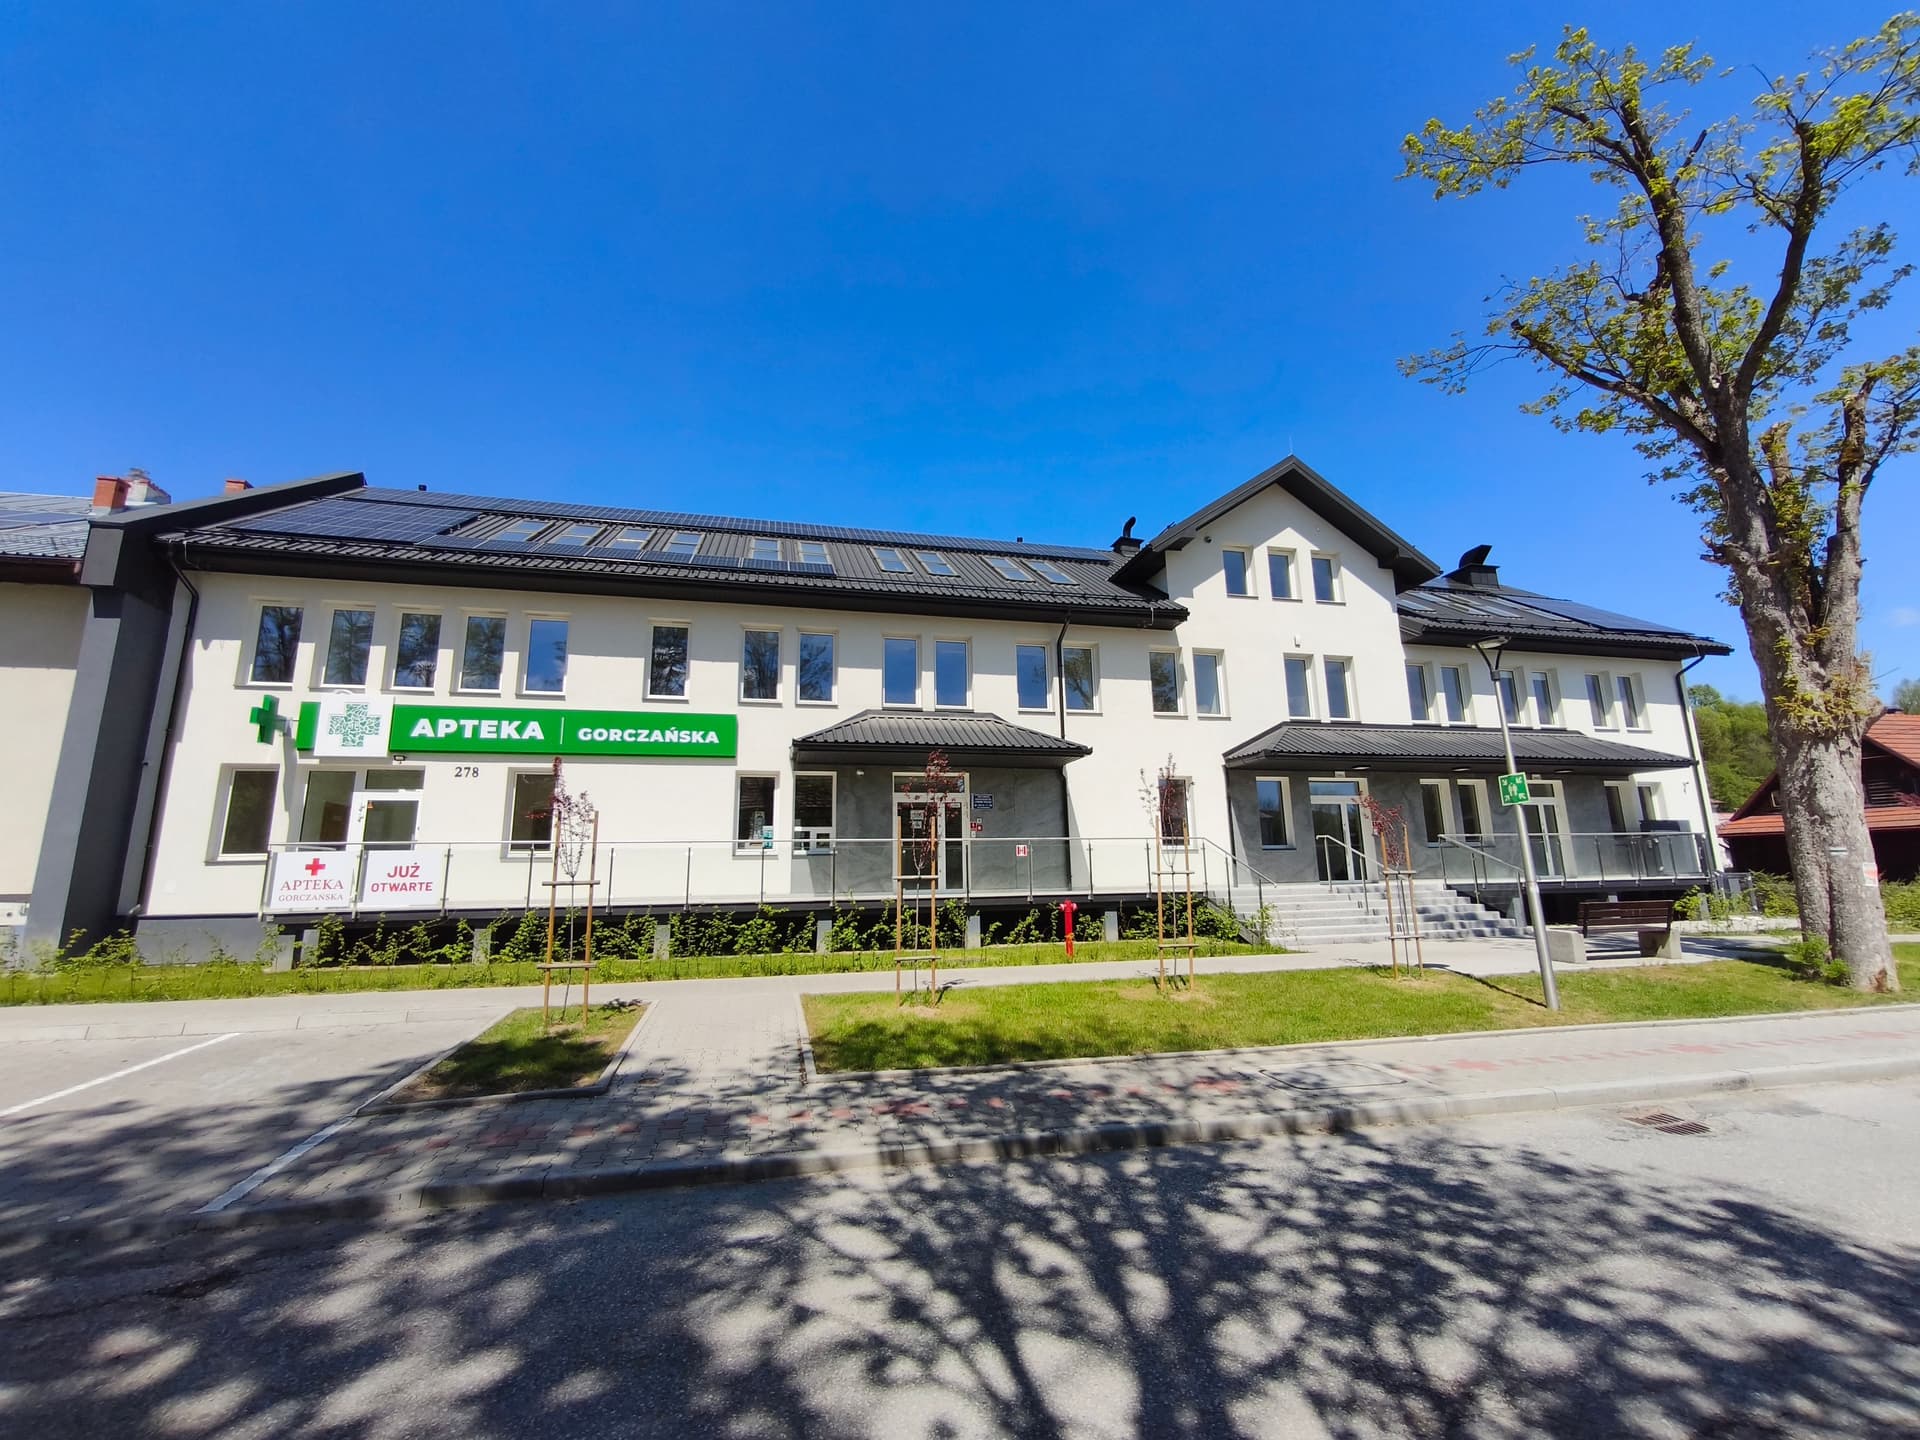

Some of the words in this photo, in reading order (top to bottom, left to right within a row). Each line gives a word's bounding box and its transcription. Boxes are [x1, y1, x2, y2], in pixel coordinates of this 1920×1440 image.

[410, 718, 544, 740] APTEKA
[577, 727, 720, 744] GORCZAŃSKA
[454, 766, 480, 778] 278
[387, 862, 421, 878] JUŻ
[280, 879, 344, 891] APTEKA
[370, 881, 433, 893] OTWARTE
